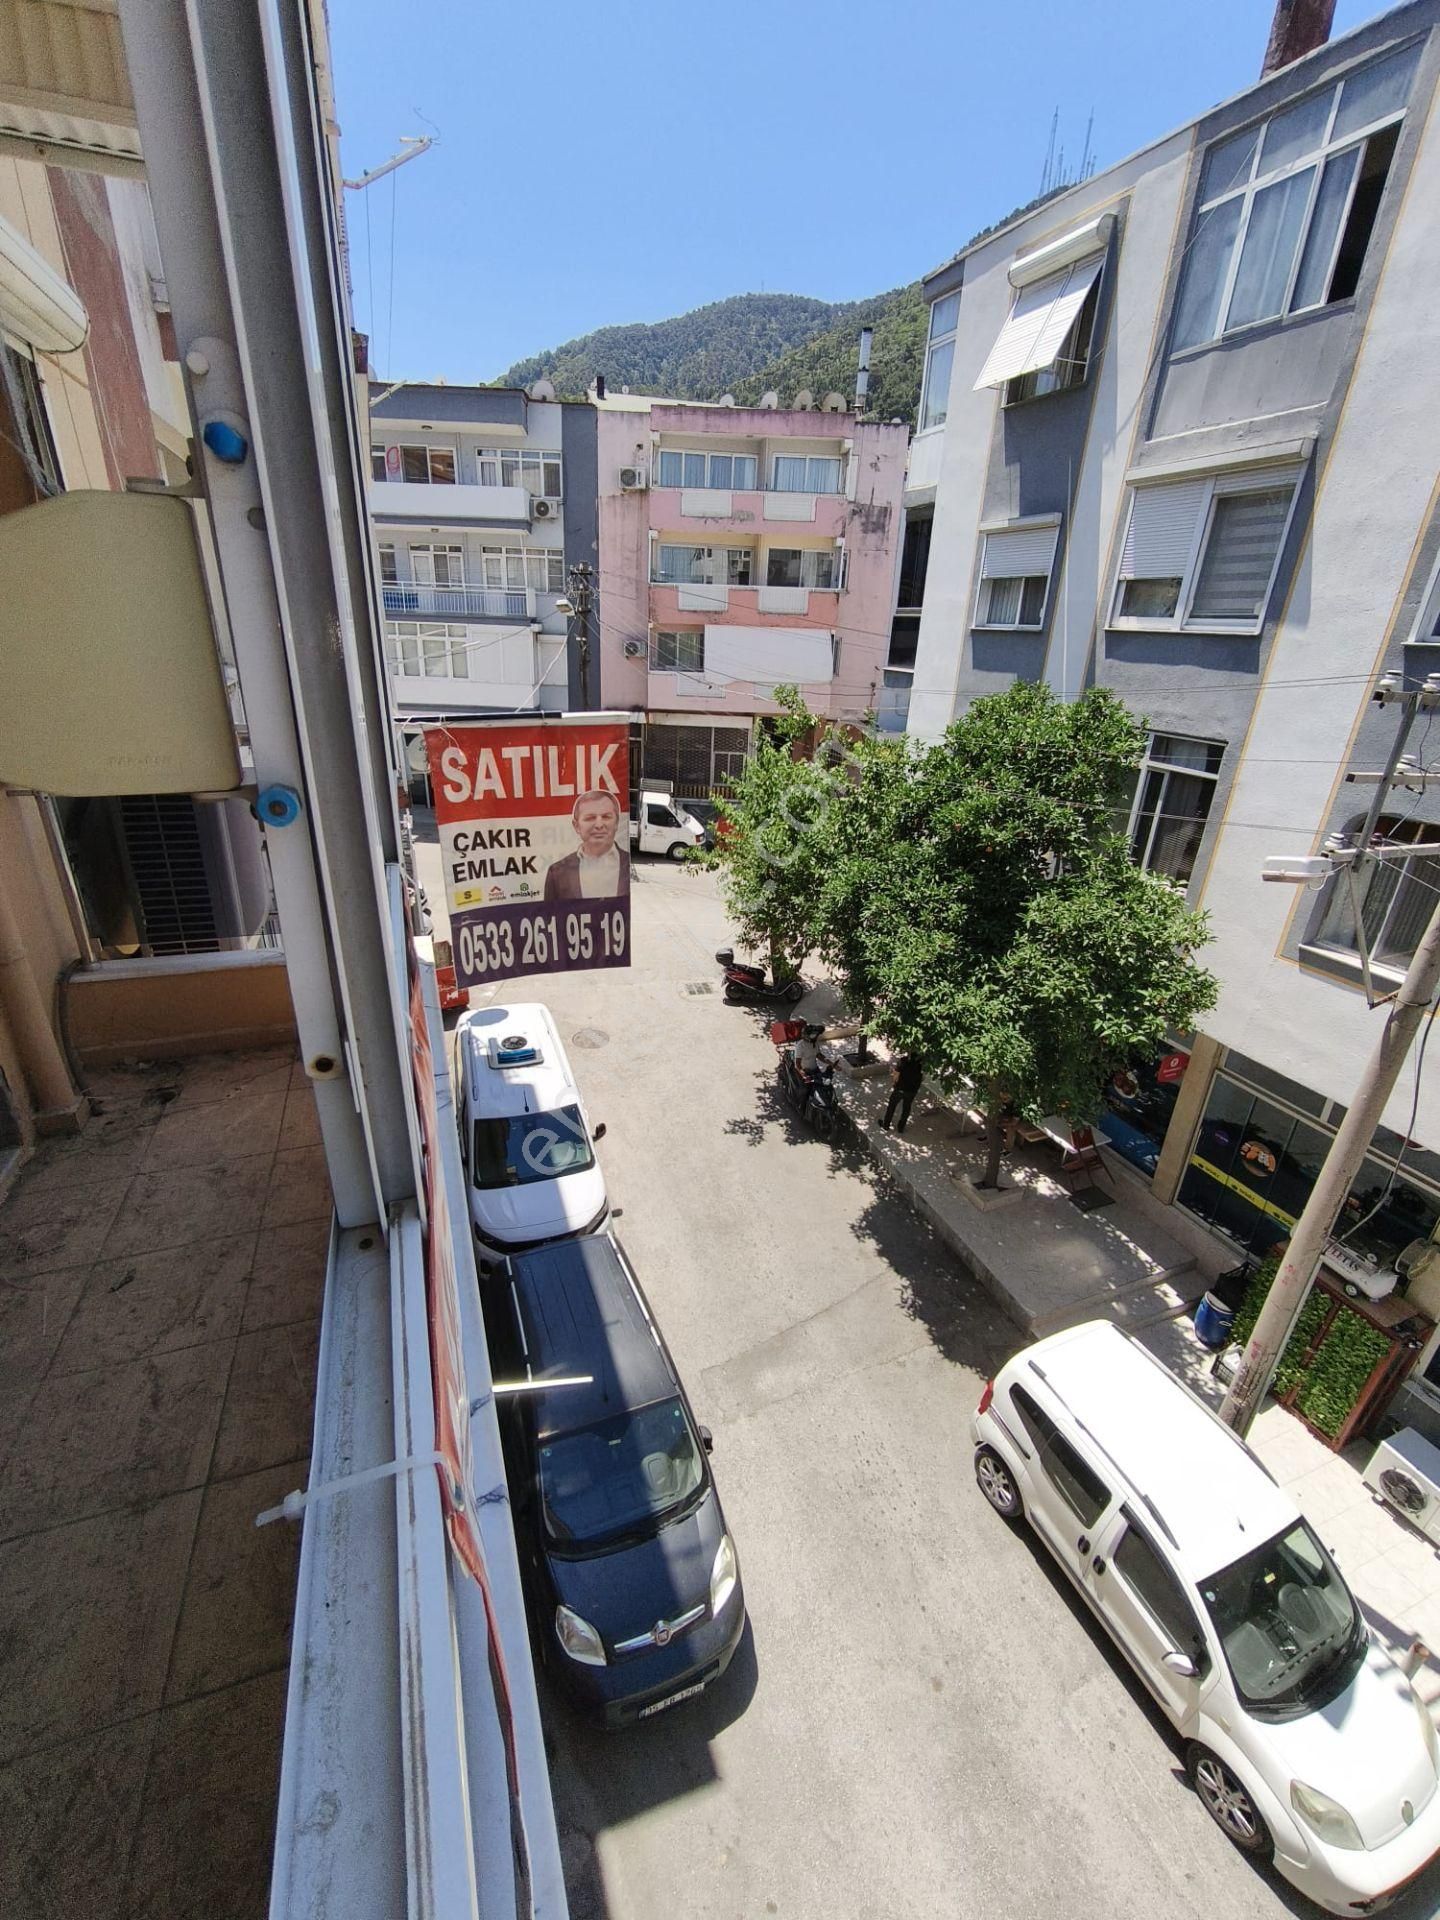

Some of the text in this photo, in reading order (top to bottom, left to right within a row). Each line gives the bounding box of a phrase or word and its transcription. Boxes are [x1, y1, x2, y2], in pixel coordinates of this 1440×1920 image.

[441, 744, 620, 803] SATILIK
[453, 828, 531, 858] ÇAKIR
[452, 855, 538, 884] EMLAK
[459, 910, 625, 975] 0533 261 95 19
